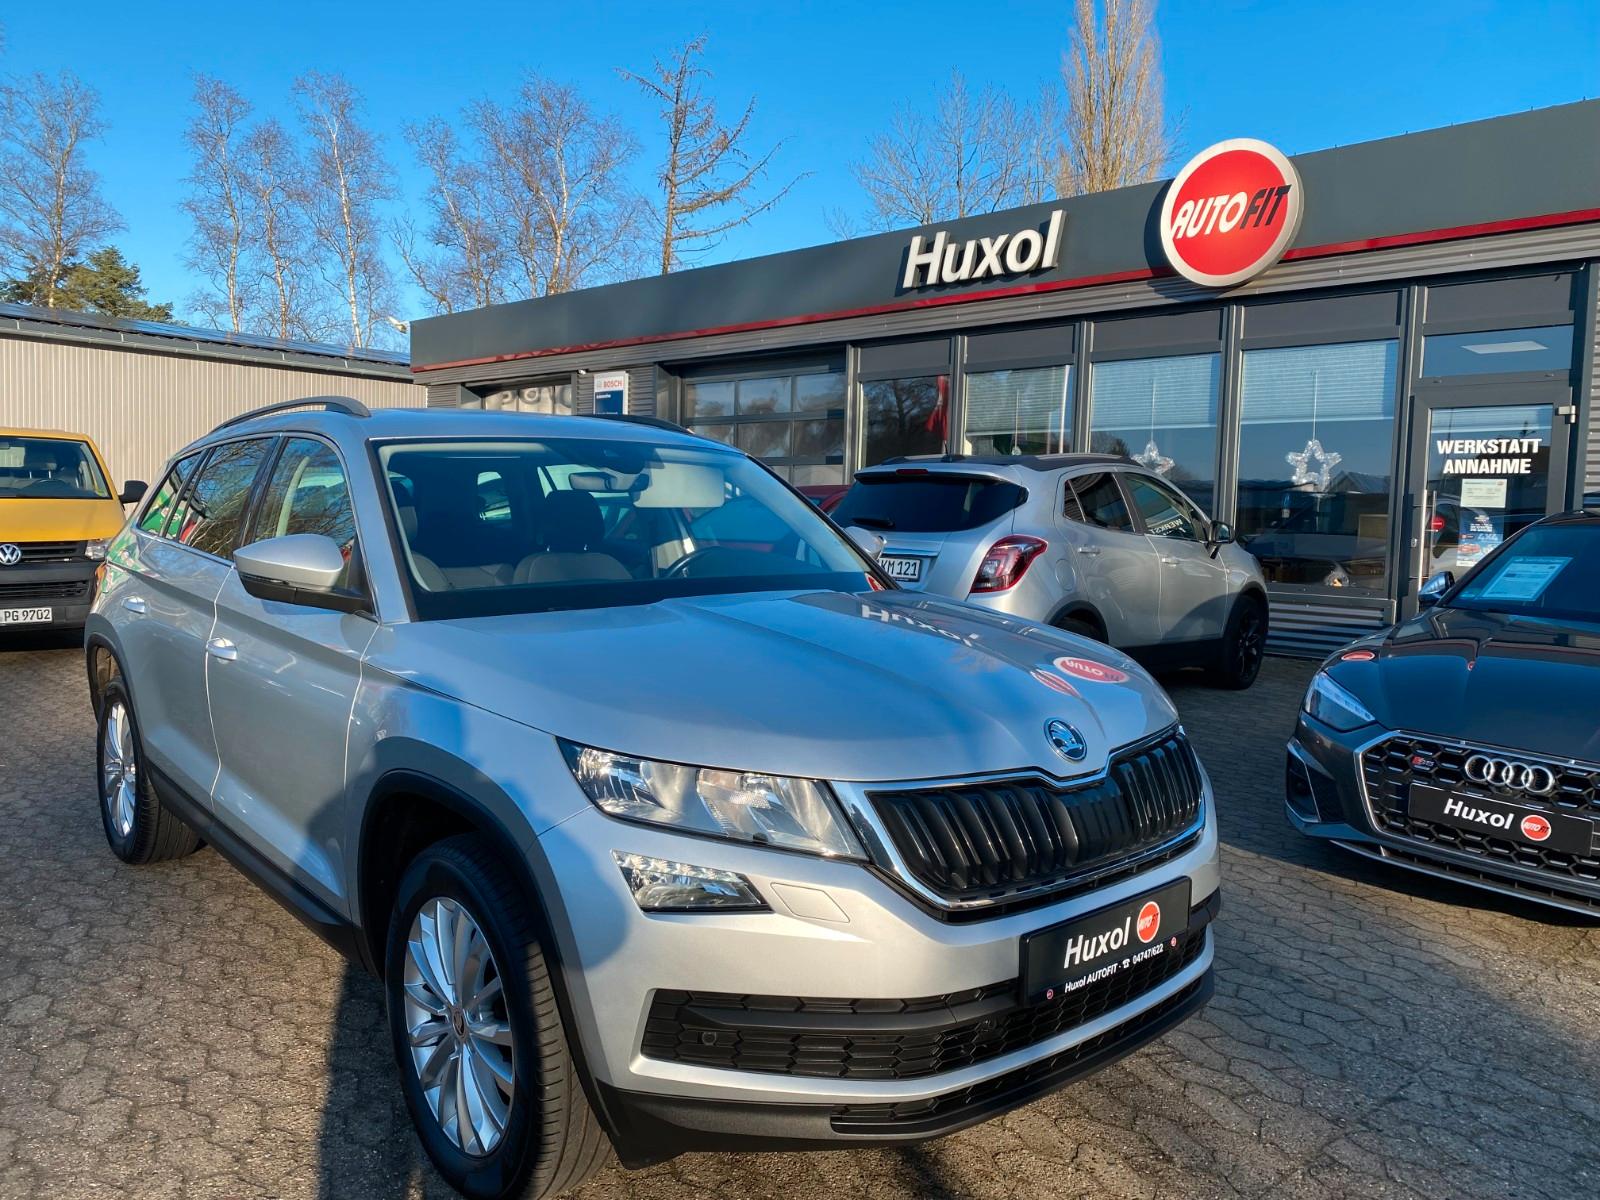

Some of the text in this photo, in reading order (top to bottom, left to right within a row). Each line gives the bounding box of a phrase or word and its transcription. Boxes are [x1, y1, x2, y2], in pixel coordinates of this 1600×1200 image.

[1171, 184, 1292, 240] AUTOFIT
[902, 209, 1066, 289] Huxol
[604, 380, 622, 388] BOSCH
[1436, 438, 1543, 455] WERKSTATT
[1442, 458, 1532, 475] ANNAHME
[896, 560, 917, 577] 121
[4, 609, 50, 621] PG 9702
[1443, 798, 1515, 830] Huxol
[1064, 916, 1131, 969] Huxol
[1064, 943, 1164, 993] Huxol AUTOFIT 04747/622
